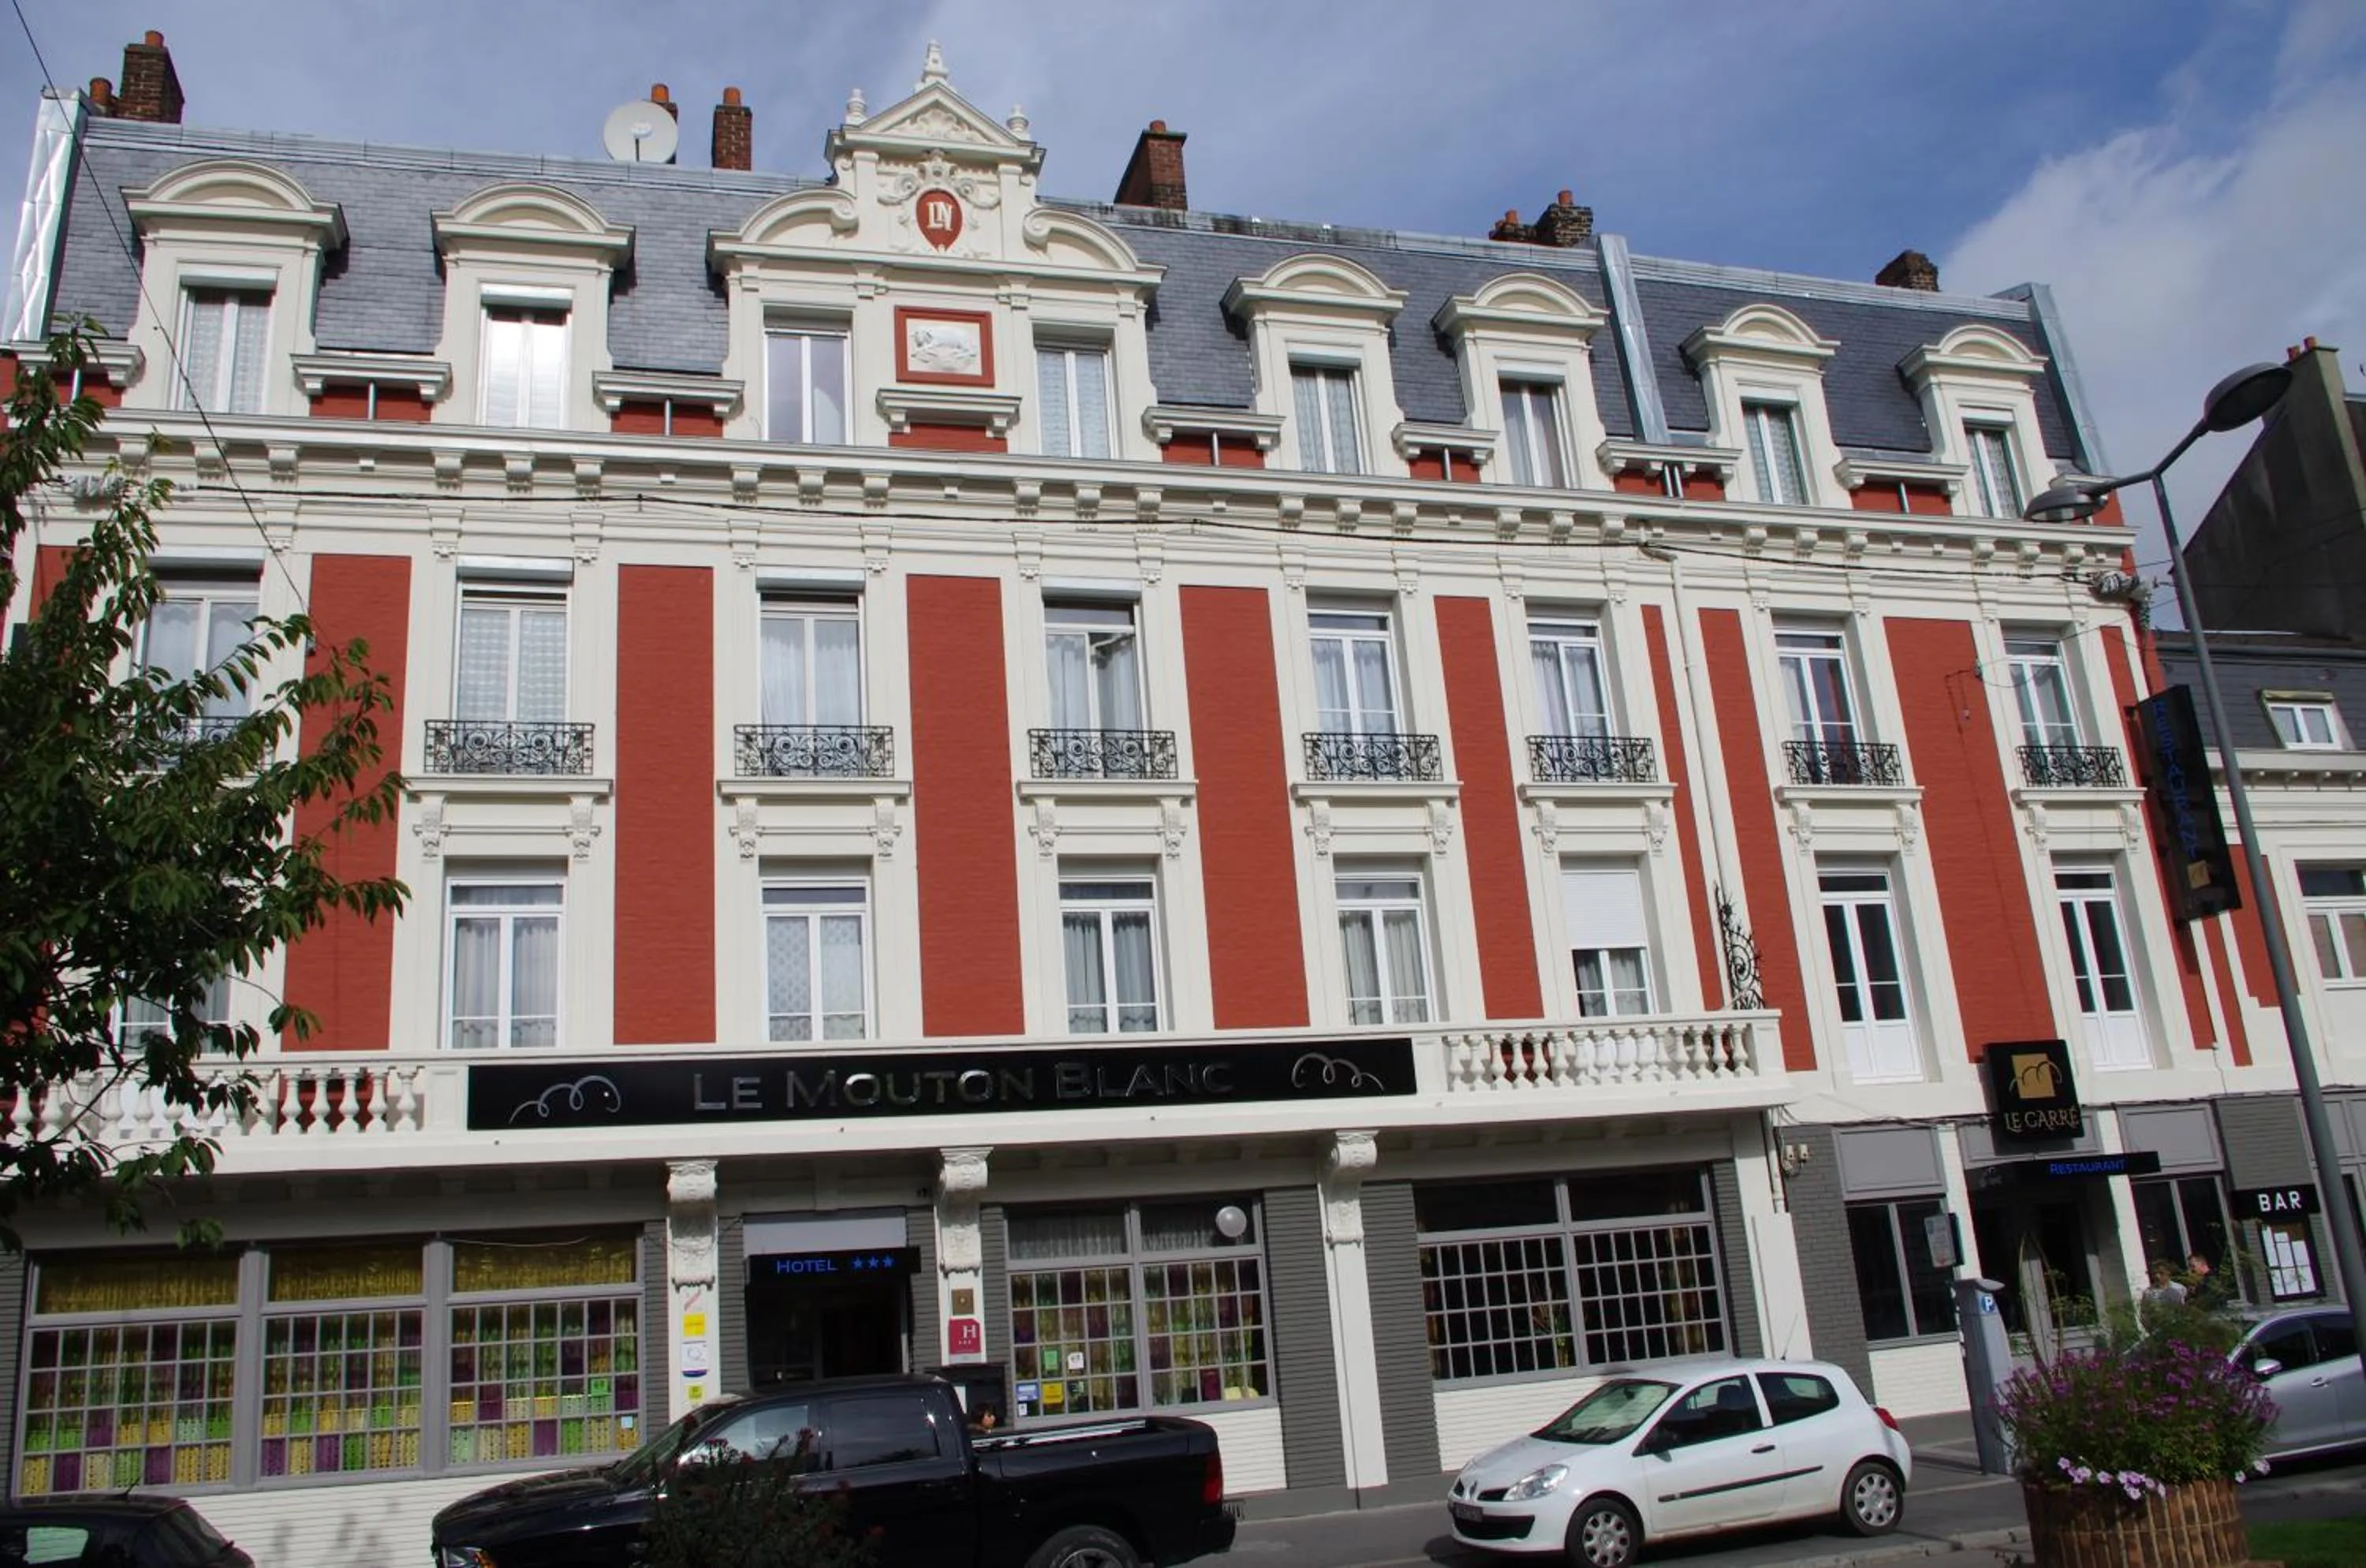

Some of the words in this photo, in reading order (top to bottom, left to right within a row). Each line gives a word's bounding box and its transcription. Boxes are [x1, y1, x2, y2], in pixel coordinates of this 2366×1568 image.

[693, 1073, 763, 1111] LE
[786, 1066, 1034, 1109] MOUTON
[1054, 1062, 1234, 1099] BLANC
[2004, 1111, 2023, 1133] LE
[2050, 1159, 2126, 1175] RESTAURANT
[2258, 1190, 2302, 1212] BAR
[777, 1259, 839, 1275] HOTEL
[1984, 1296, 1995, 1312] P
[962, 1324, 976, 1338] H
